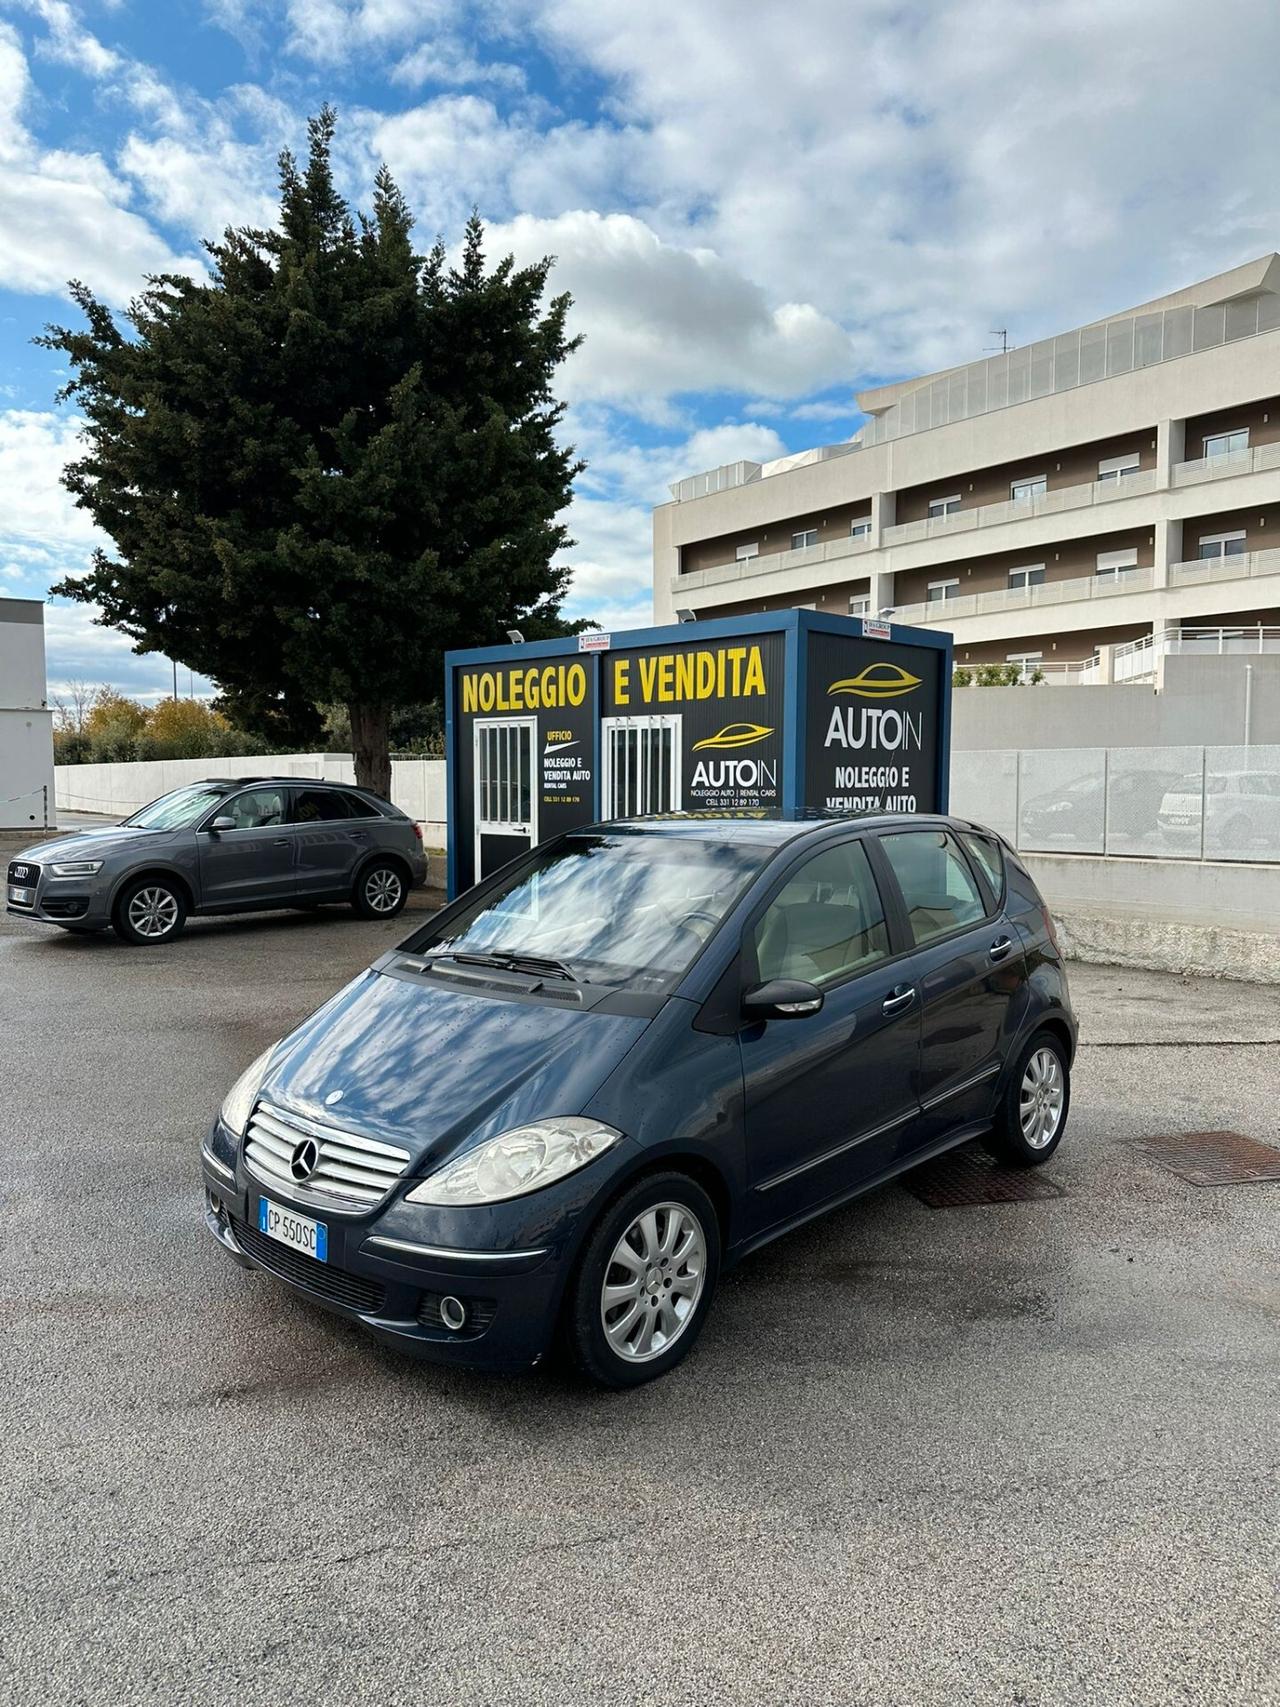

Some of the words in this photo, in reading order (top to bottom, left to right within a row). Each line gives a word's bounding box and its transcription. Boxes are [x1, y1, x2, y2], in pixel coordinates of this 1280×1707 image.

[462, 663, 586, 712] NOLEGGIO
[615, 660, 629, 705] E
[639, 646, 766, 703] VENDITA
[547, 731, 572, 741] UFFICIO
[824, 706, 922, 751] AUTOIN
[544, 758, 576, 768] NOLEGGIO
[577, 757, 582, 767] E
[544, 770, 571, 781] VENDITA
[573, 770, 591, 781] AUTO
[691, 759, 776, 787] AUTOIN
[835, 766, 898, 788] NOLEGGIO
[902, 767, 909, 787] E
[691, 789, 720, 797] NOLEGGIO
[720, 789, 735, 797] AUTO
[740, 789, 759, 797] RENTAL
[760, 789, 776, 797] CARS
[885, 795, 917, 813] AUTO
[269, 1209, 280, 1232] CP
